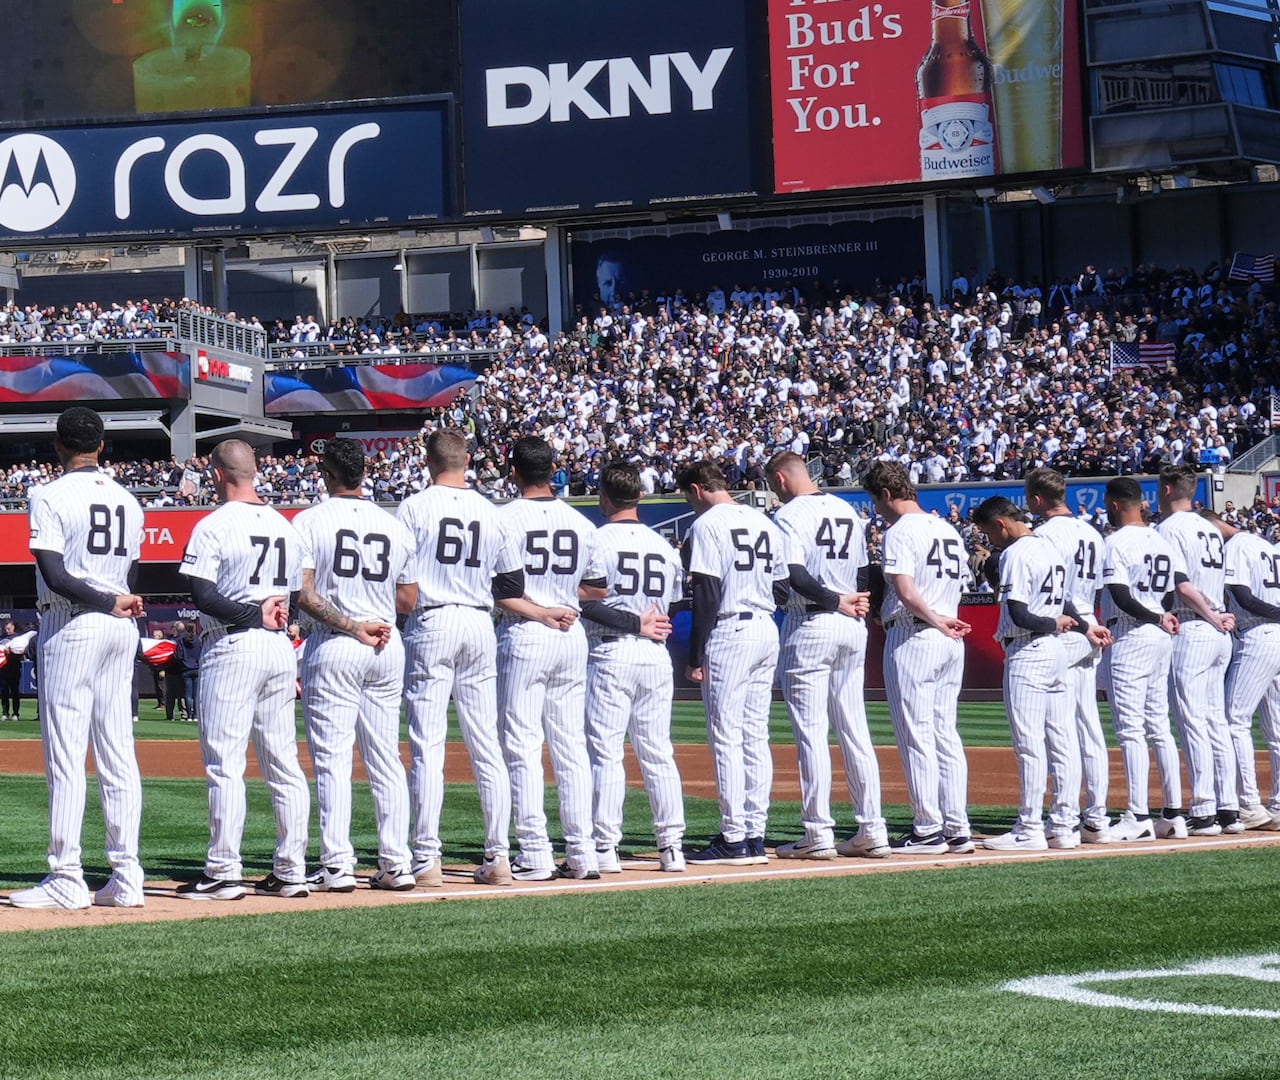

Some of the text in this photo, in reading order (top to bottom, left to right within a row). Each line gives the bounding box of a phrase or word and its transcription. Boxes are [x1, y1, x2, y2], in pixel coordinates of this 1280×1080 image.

[785, 4, 903, 48] Bud's
[486, 47, 733, 128] DKNY
[787, 54, 859, 91] For
[786, 96, 881, 133] You.
[114, 122, 381, 220] razr
[924, 154, 991, 170] Budweiser
[702, 241, 878, 263] GEORGE M. STEINBRENNER III
[763, 266, 819, 279] 1930-2010
[86, 503, 128, 557] 81
[439, 517, 481, 568] 61
[731, 528, 773, 574] 54
[815, 518, 854, 560] 47
[1197, 531, 1224, 569] 33
[249, 536, 288, 587] 71
[333, 529, 390, 583] 63
[525, 529, 578, 575] 59
[927, 538, 960, 580] 45
[1074, 539, 1098, 581] 41
[1137, 554, 1171, 592] 38
[614, 551, 666, 598] 56
[1040, 565, 1066, 606] 43
[961, 595, 993, 604] StubHub
